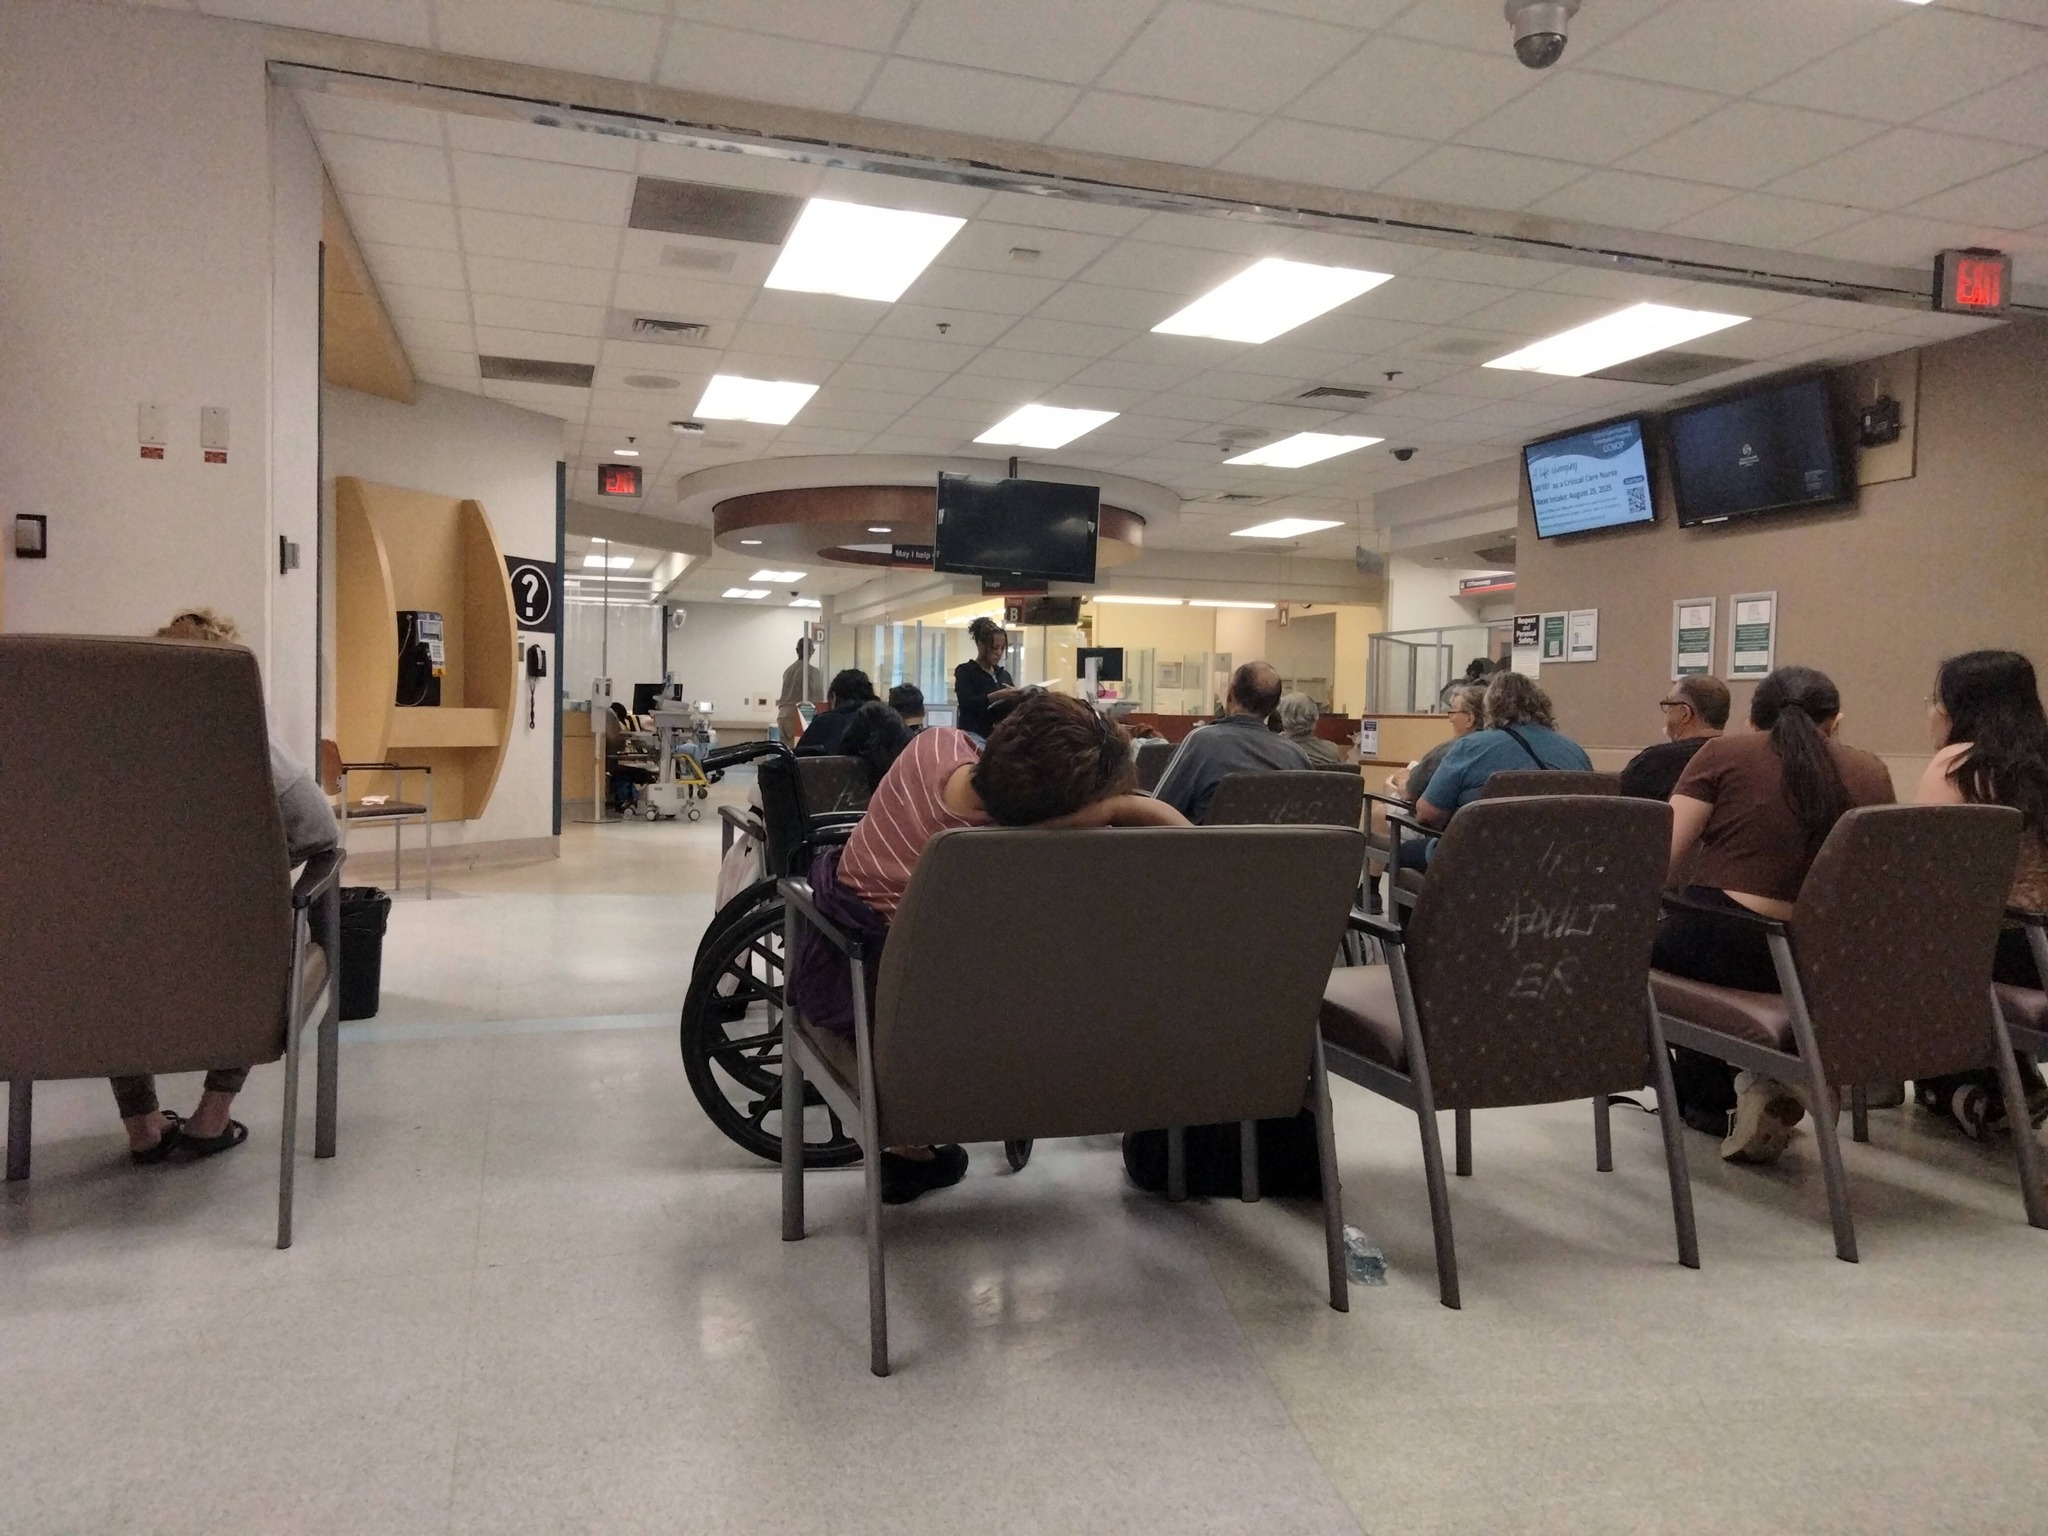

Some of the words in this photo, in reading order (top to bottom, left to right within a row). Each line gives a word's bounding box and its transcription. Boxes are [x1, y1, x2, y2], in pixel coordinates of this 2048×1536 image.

[1957, 254, 2001, 307] EXIT
[1564, 475, 1584, 487] Critical
[1585, 474, 1599, 483] Care
[1599, 470, 1618, 480] Nurse
[1535, 497, 1549, 506] Next
[1568, 489, 1589, 500] August
[1598, 484, 1613, 493] 2025
[895, 549, 910, 560] May
[915, 551, 931, 560] help
[985, 581, 1001, 589] Triage
[1010, 607, 1018, 622] B
[1280, 610, 1287, 625] A
[1517, 617, 1537, 625] Respect
[817, 630, 824, 641] D
[1516, 629, 1537, 637] Personal
